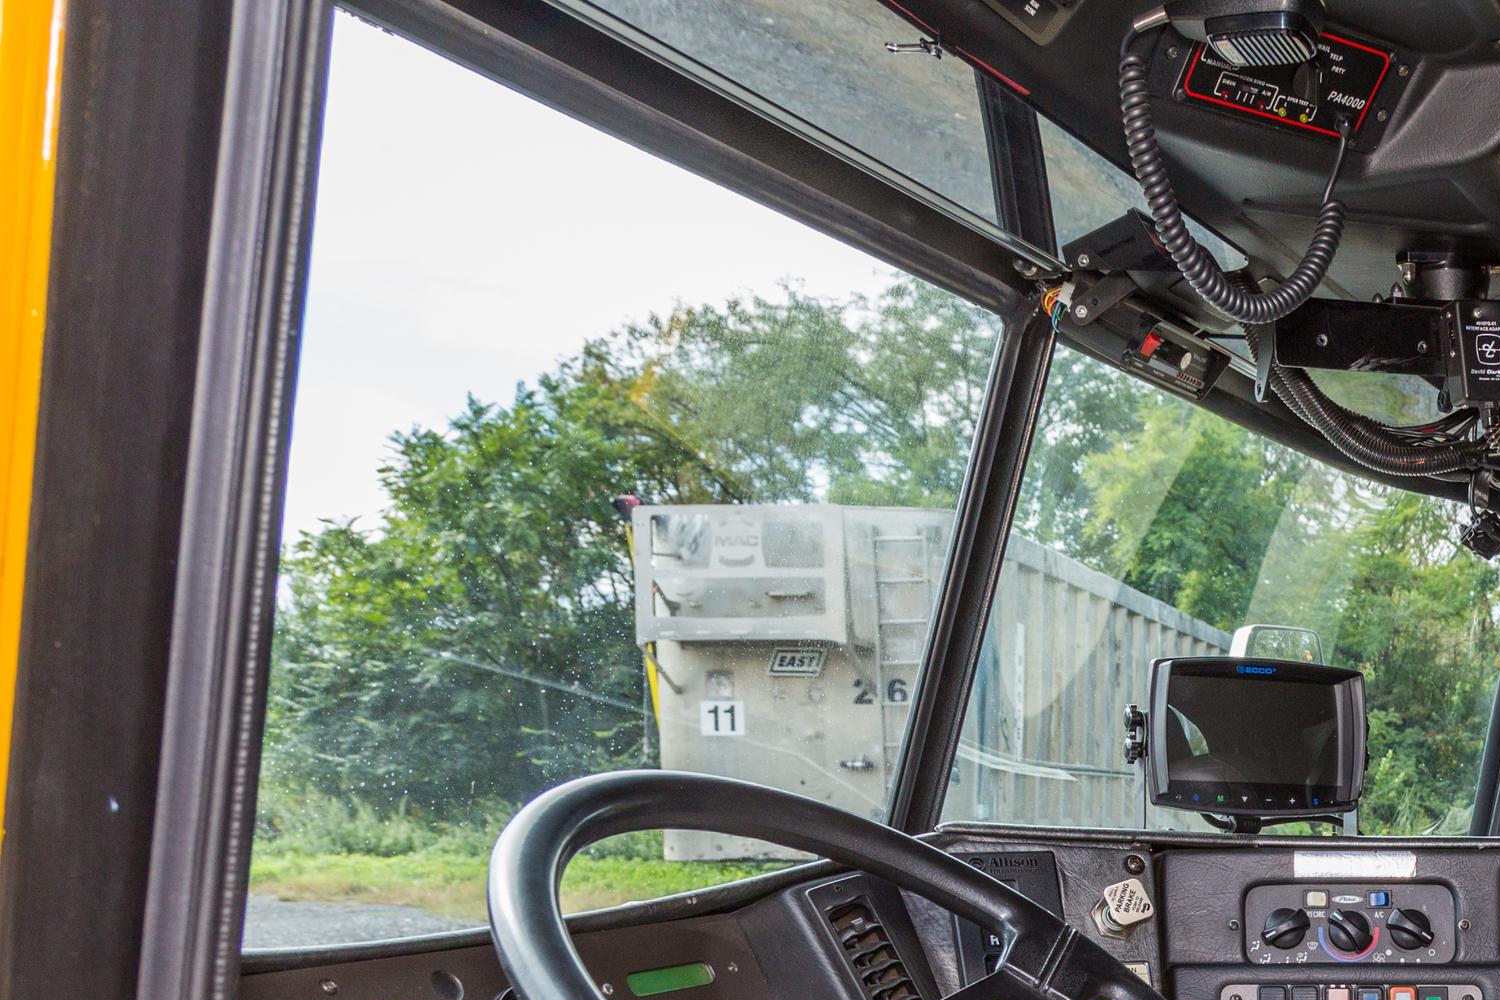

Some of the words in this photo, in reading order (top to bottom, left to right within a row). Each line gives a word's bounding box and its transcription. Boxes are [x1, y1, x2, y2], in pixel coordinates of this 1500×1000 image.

[1206, 58, 1233, 71] MANUAL
[1327, 90, 1366, 110] PA4000
[778, 656, 816, 668] EAST
[707, 705, 736, 732] 11
[990, 858, 1039, 867] Allison
[1115, 883, 1130, 913] PARKING
[1124, 889, 1136, 913] BRAKE
[990, 934, 1000, 946] R
